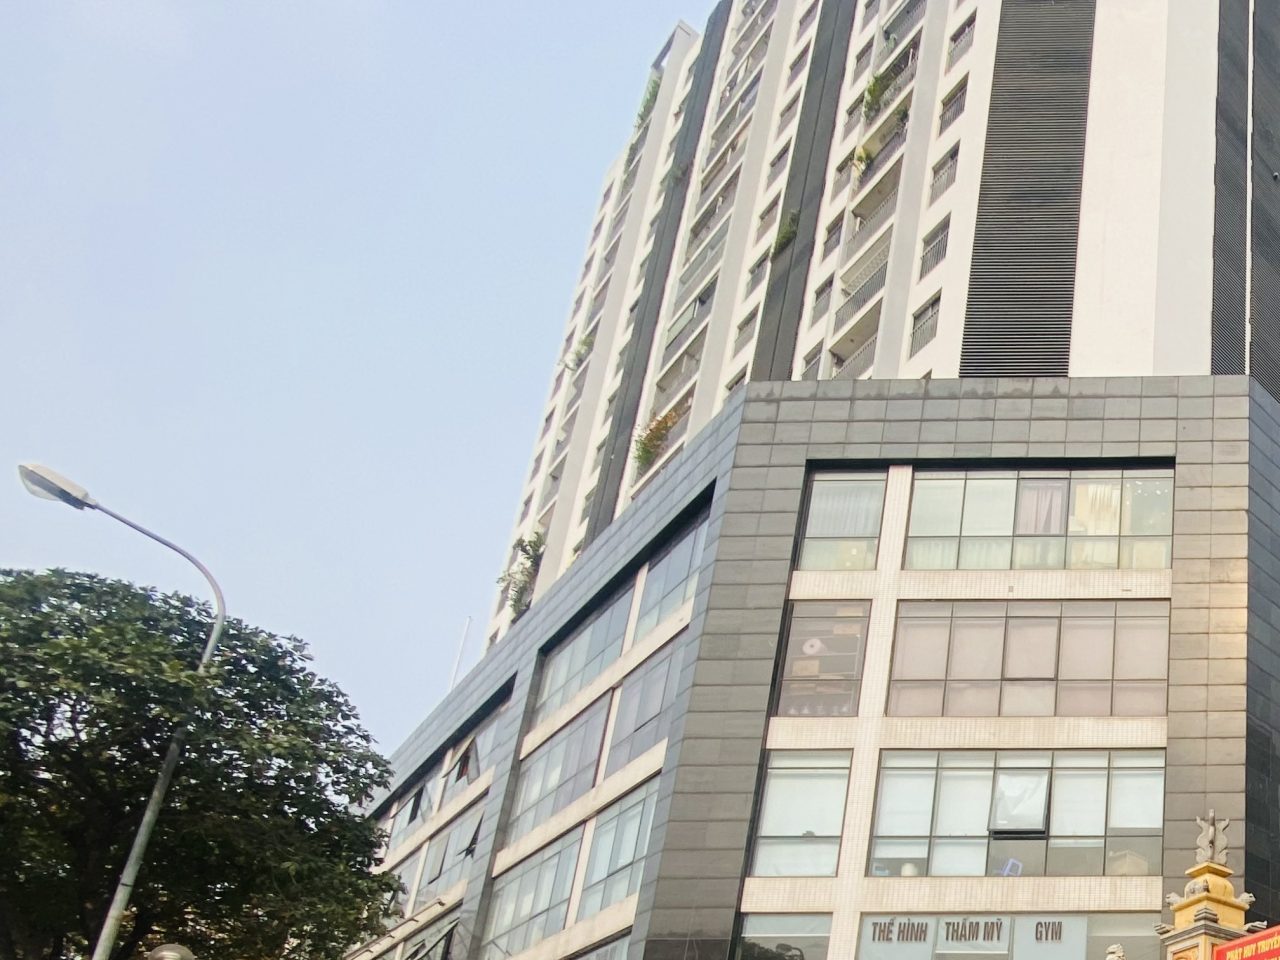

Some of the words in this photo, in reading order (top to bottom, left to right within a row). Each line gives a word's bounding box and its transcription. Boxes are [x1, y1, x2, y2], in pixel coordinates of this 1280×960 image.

[872, 917, 896, 942] THỂ
[897, 918, 928, 942] HÌNH
[945, 916, 980, 942] THẨM
[983, 918, 1003, 942] MỸ
[1035, 921, 1062, 943] GYM
[1243, 943, 1256, 959] HUY
